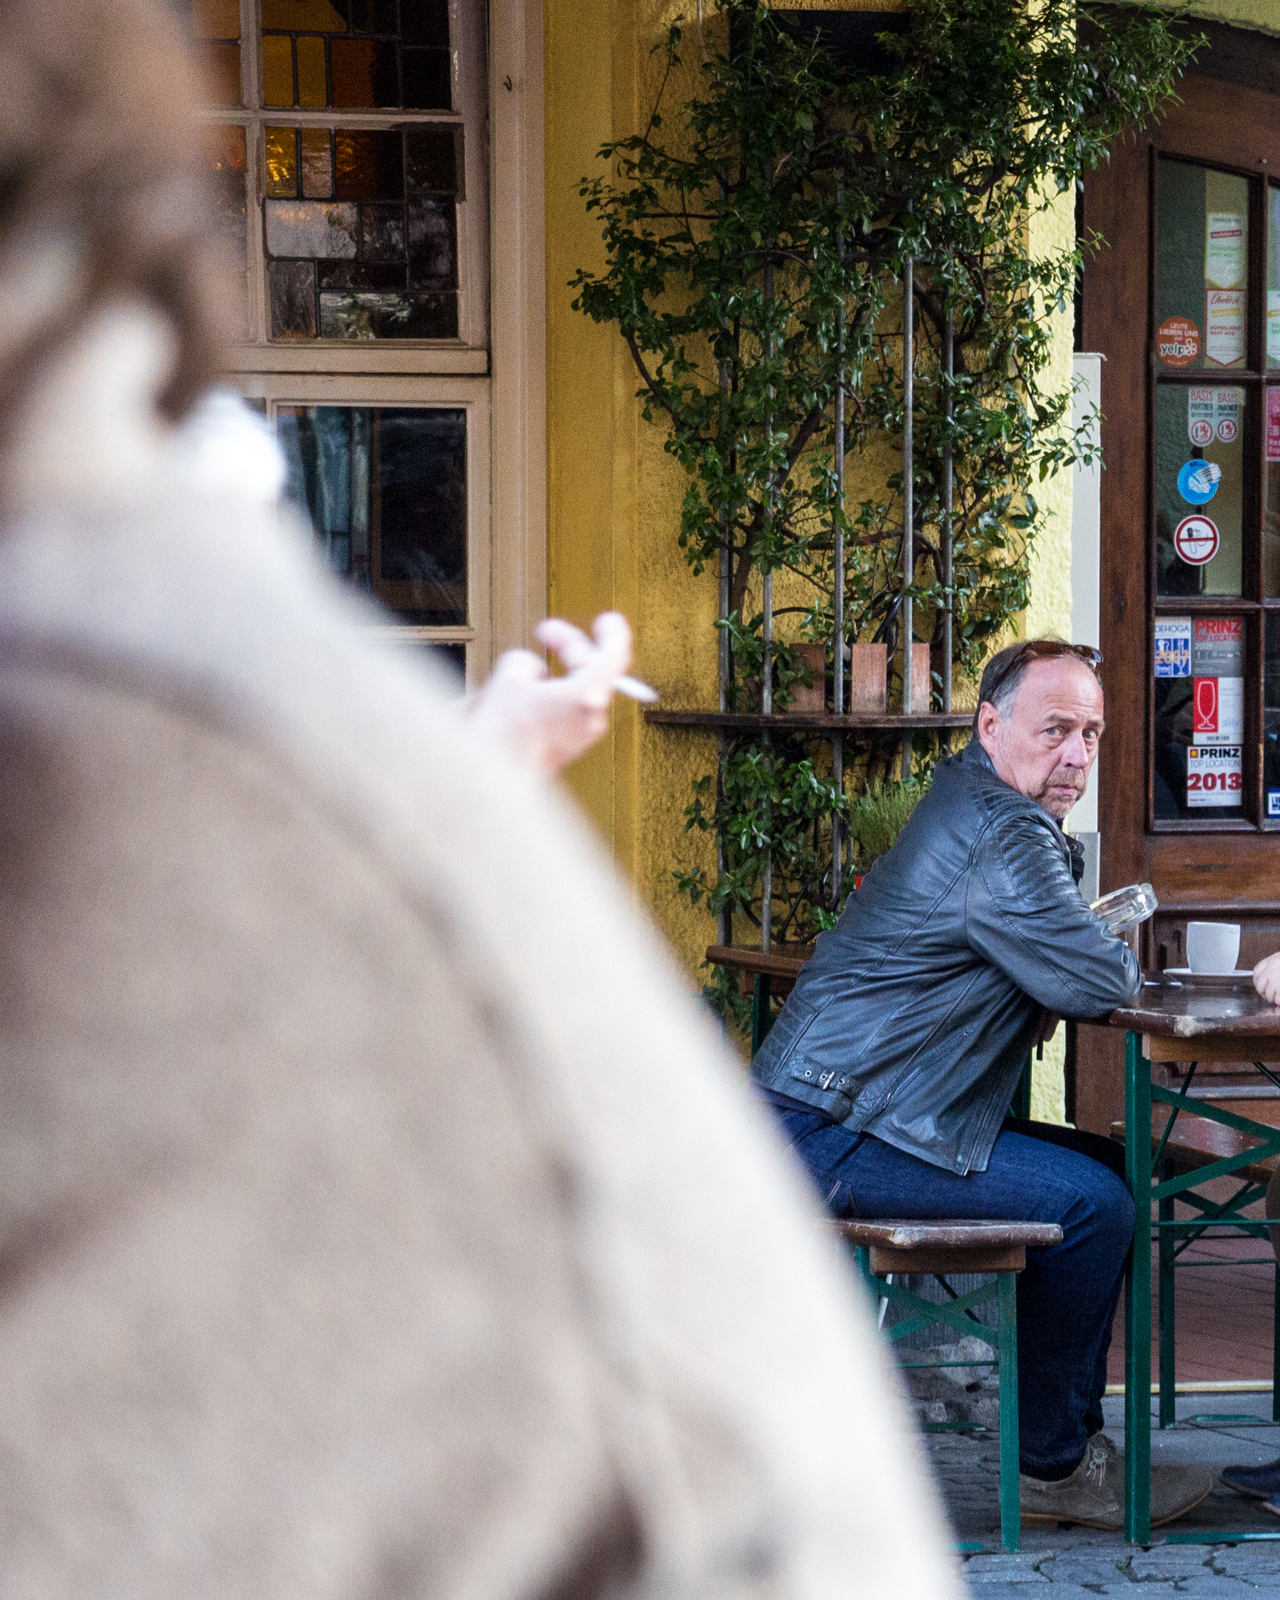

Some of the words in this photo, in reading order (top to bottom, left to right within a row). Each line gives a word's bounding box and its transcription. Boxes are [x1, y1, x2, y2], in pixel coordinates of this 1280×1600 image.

[1160, 343, 1186, 357] yelp
[1190, 389, 1213, 401] BASIS
[1217, 393, 1239, 403] BASIS
[1155, 624, 1190, 633] DEHOGA
[1194, 619, 1243, 634] PRINZ
[1195, 633, 1208, 642] TOP
[1155, 649, 1189, 665] 2007
[1200, 748, 1240, 759] PRINZ
[1190, 759, 1203, 768] TOP
[1205, 759, 1241, 768] LOCATION
[1187, 772, 1242, 791] 2013
